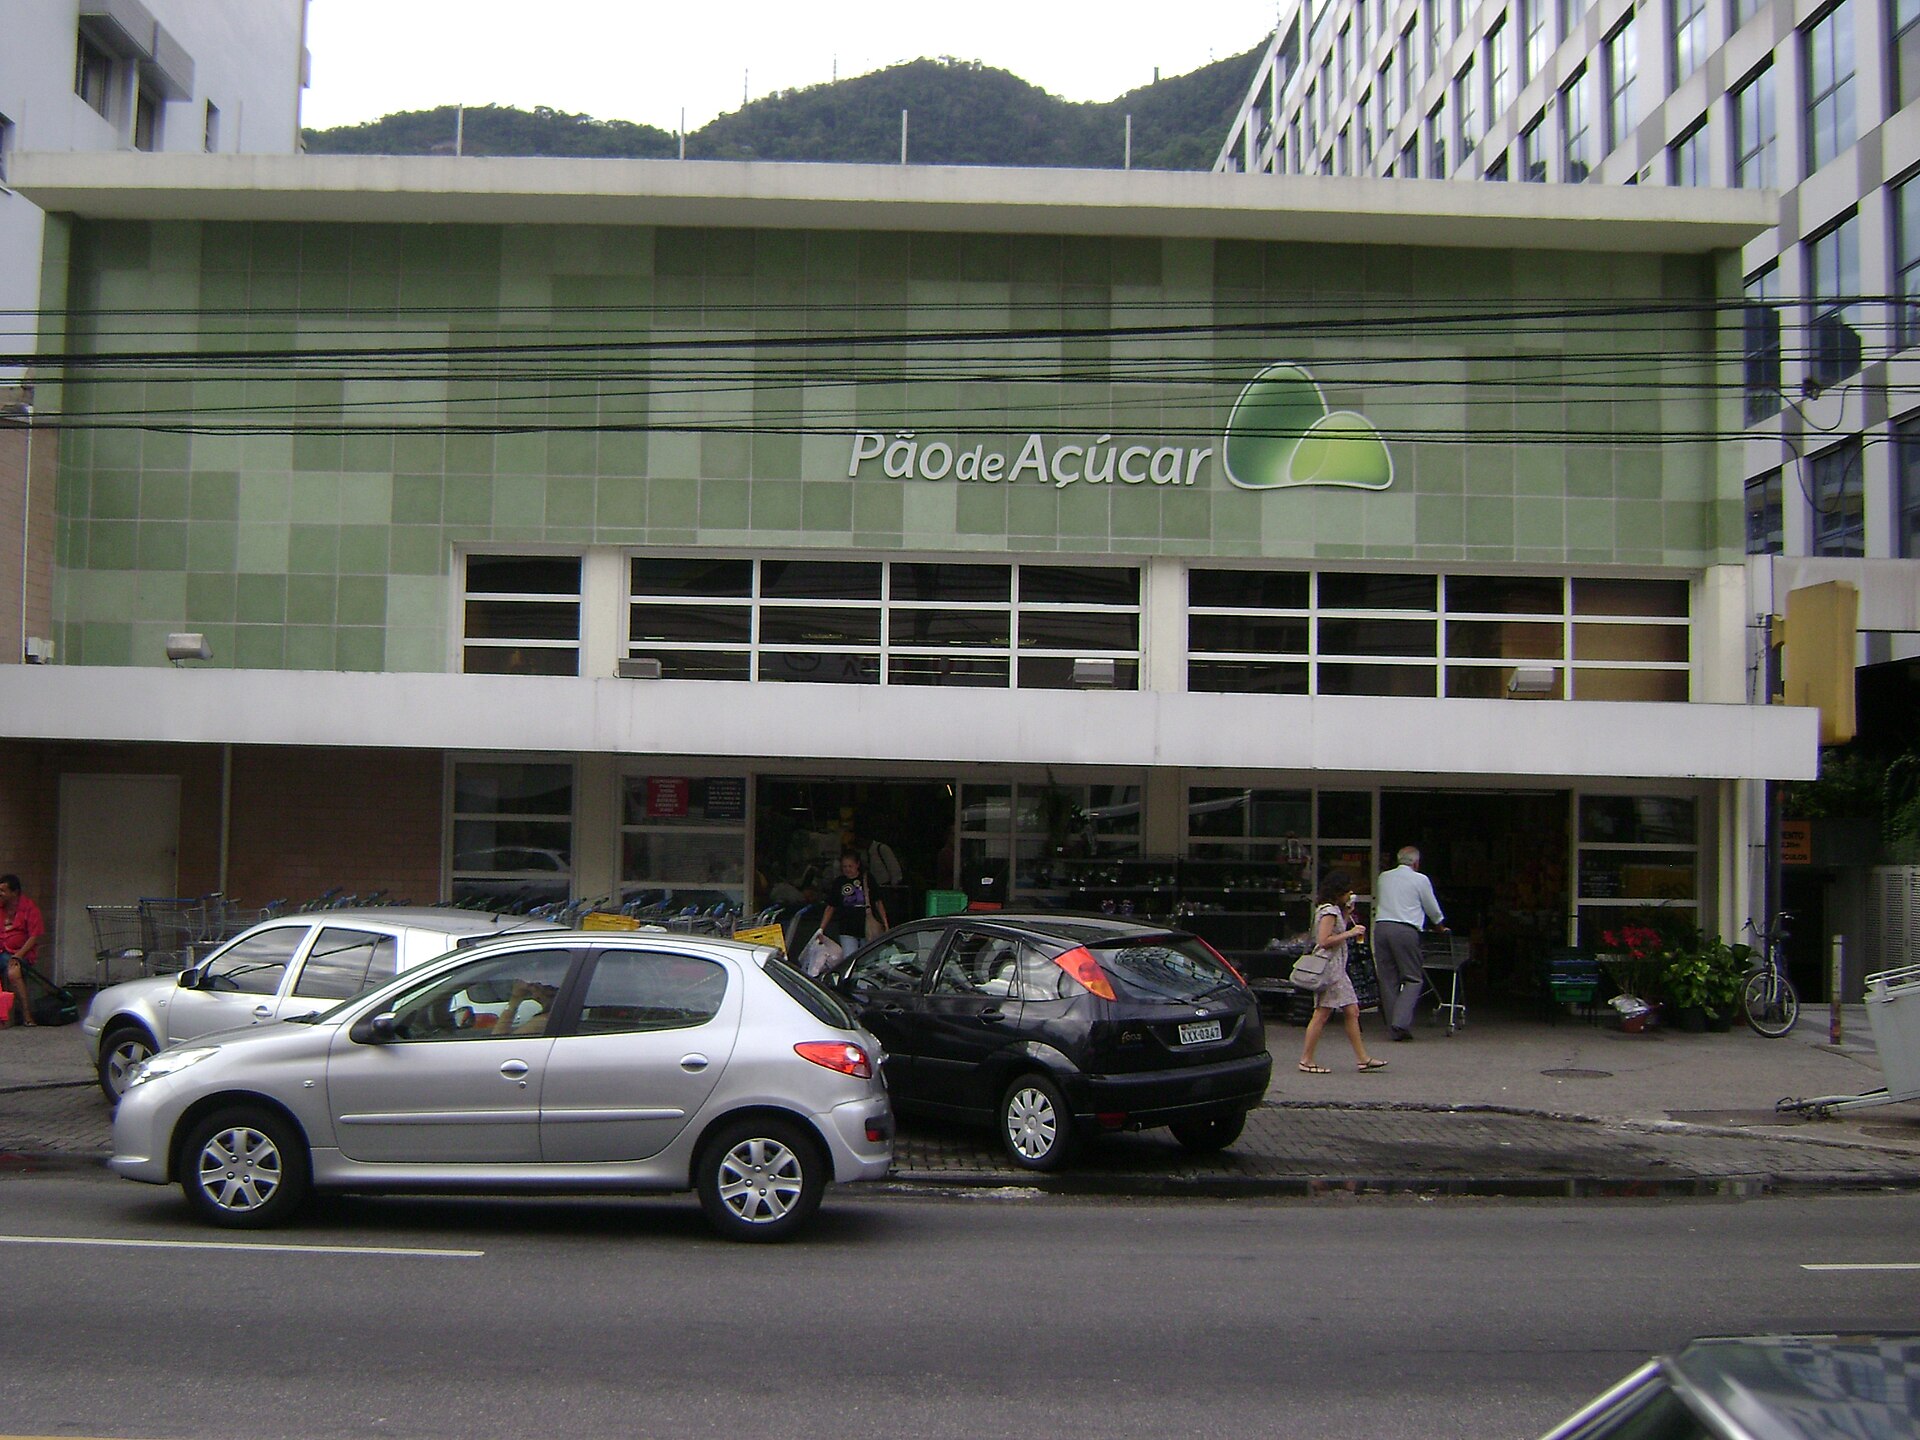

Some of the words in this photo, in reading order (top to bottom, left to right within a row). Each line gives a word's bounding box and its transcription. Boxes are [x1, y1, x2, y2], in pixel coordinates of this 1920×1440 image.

[848, 430, 953, 481] Pão
[955, 444, 1005, 482] de
[1008, 433, 1213, 488] Açúcar
